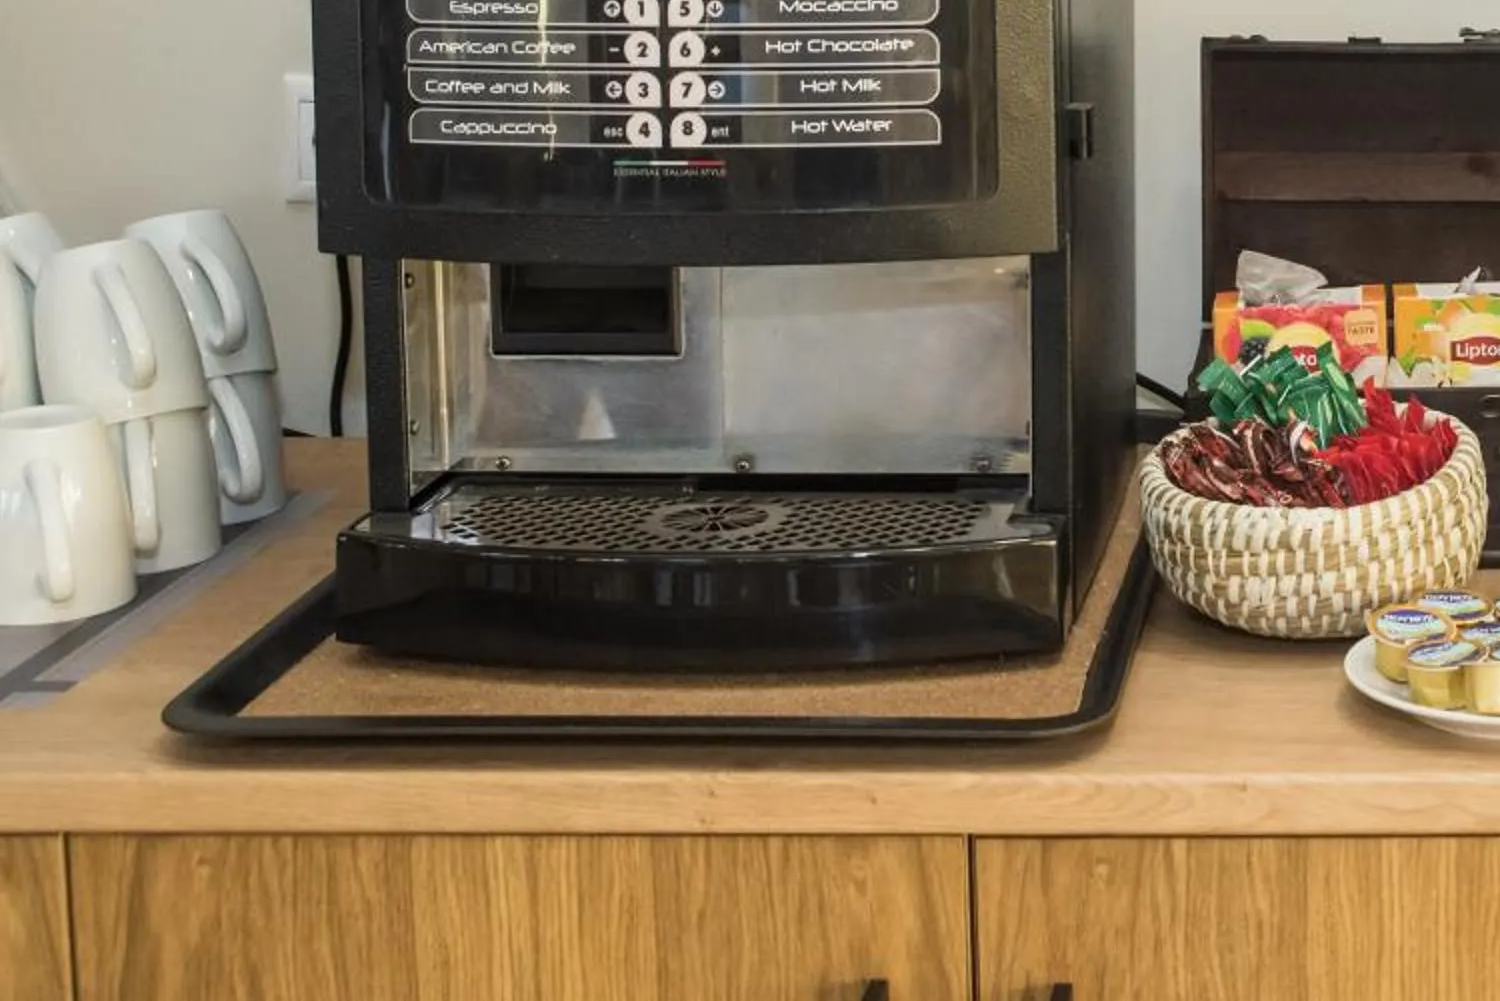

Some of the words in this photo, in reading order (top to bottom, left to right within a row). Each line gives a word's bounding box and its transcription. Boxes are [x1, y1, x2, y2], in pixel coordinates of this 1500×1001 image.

[449, 0, 539, 16] Espresso
[636, 0, 646, 17] 1
[678, 1, 691, 17] 5
[778, 0, 899, 13] Mocaccino
[419, 40, 508, 55] American
[511, 40, 577, 55] Coffee
[636, 41, 649, 58] 2
[679, 41, 691, 57] 6
[765, 40, 802, 55] Hot
[807, 37, 916, 54] Chocolate
[425, 79, 485, 94] Coffee
[489, 80, 529, 95] and
[533, 80, 572, 95] Milk
[638, 82, 650, 98] 3
[681, 82, 693, 98] 7
[800, 79, 836, 94] Hot
[842, 78, 882, 93] Milk
[440, 120, 559, 136] Cappuccino
[603, 127, 624, 139] esc
[638, 121, 650, 139] 4
[681, 120, 694, 137] 8
[791, 119, 828, 135] Hot
[832, 117, 893, 133] Water
